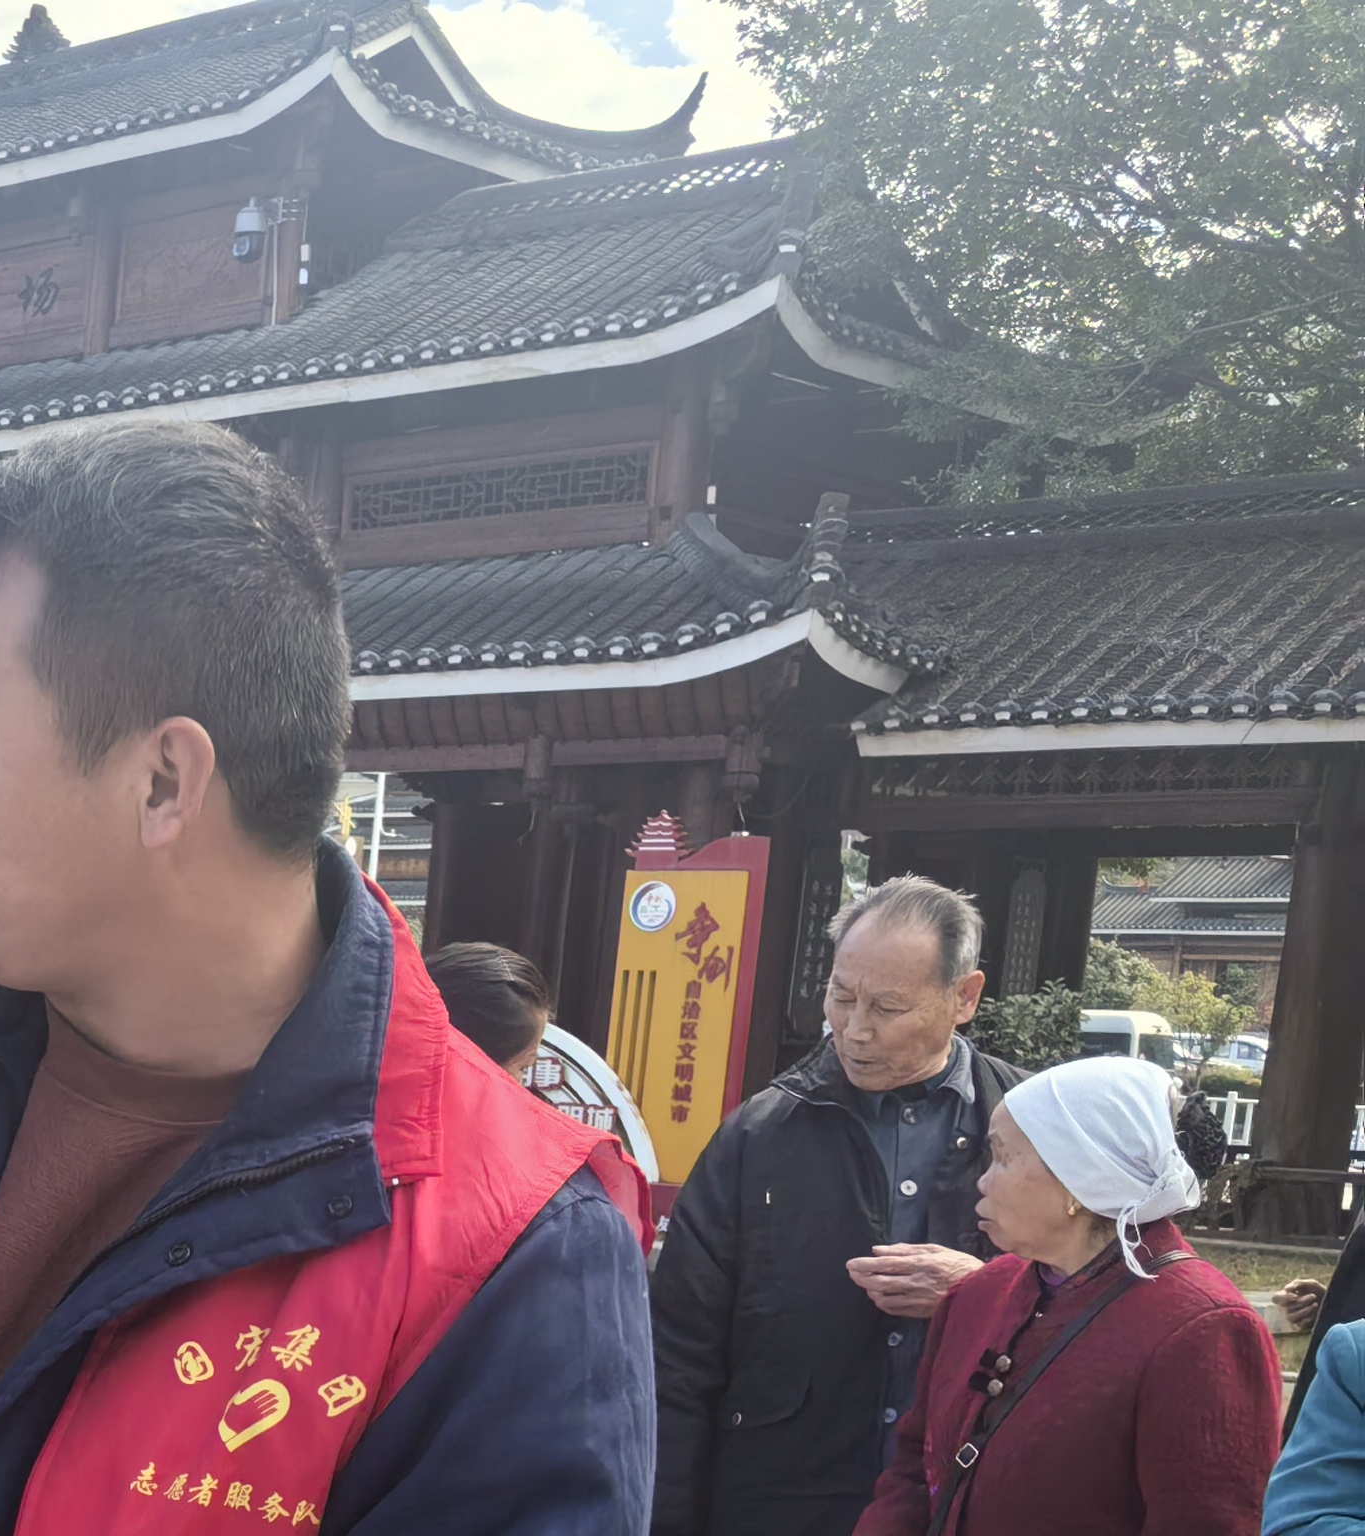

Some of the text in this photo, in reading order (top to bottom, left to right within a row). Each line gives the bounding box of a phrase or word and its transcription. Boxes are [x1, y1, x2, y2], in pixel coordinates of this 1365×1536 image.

[670, 980, 702, 1123] 自治区文明城市
[130, 1462, 320, 1527] 志愿者服务队
